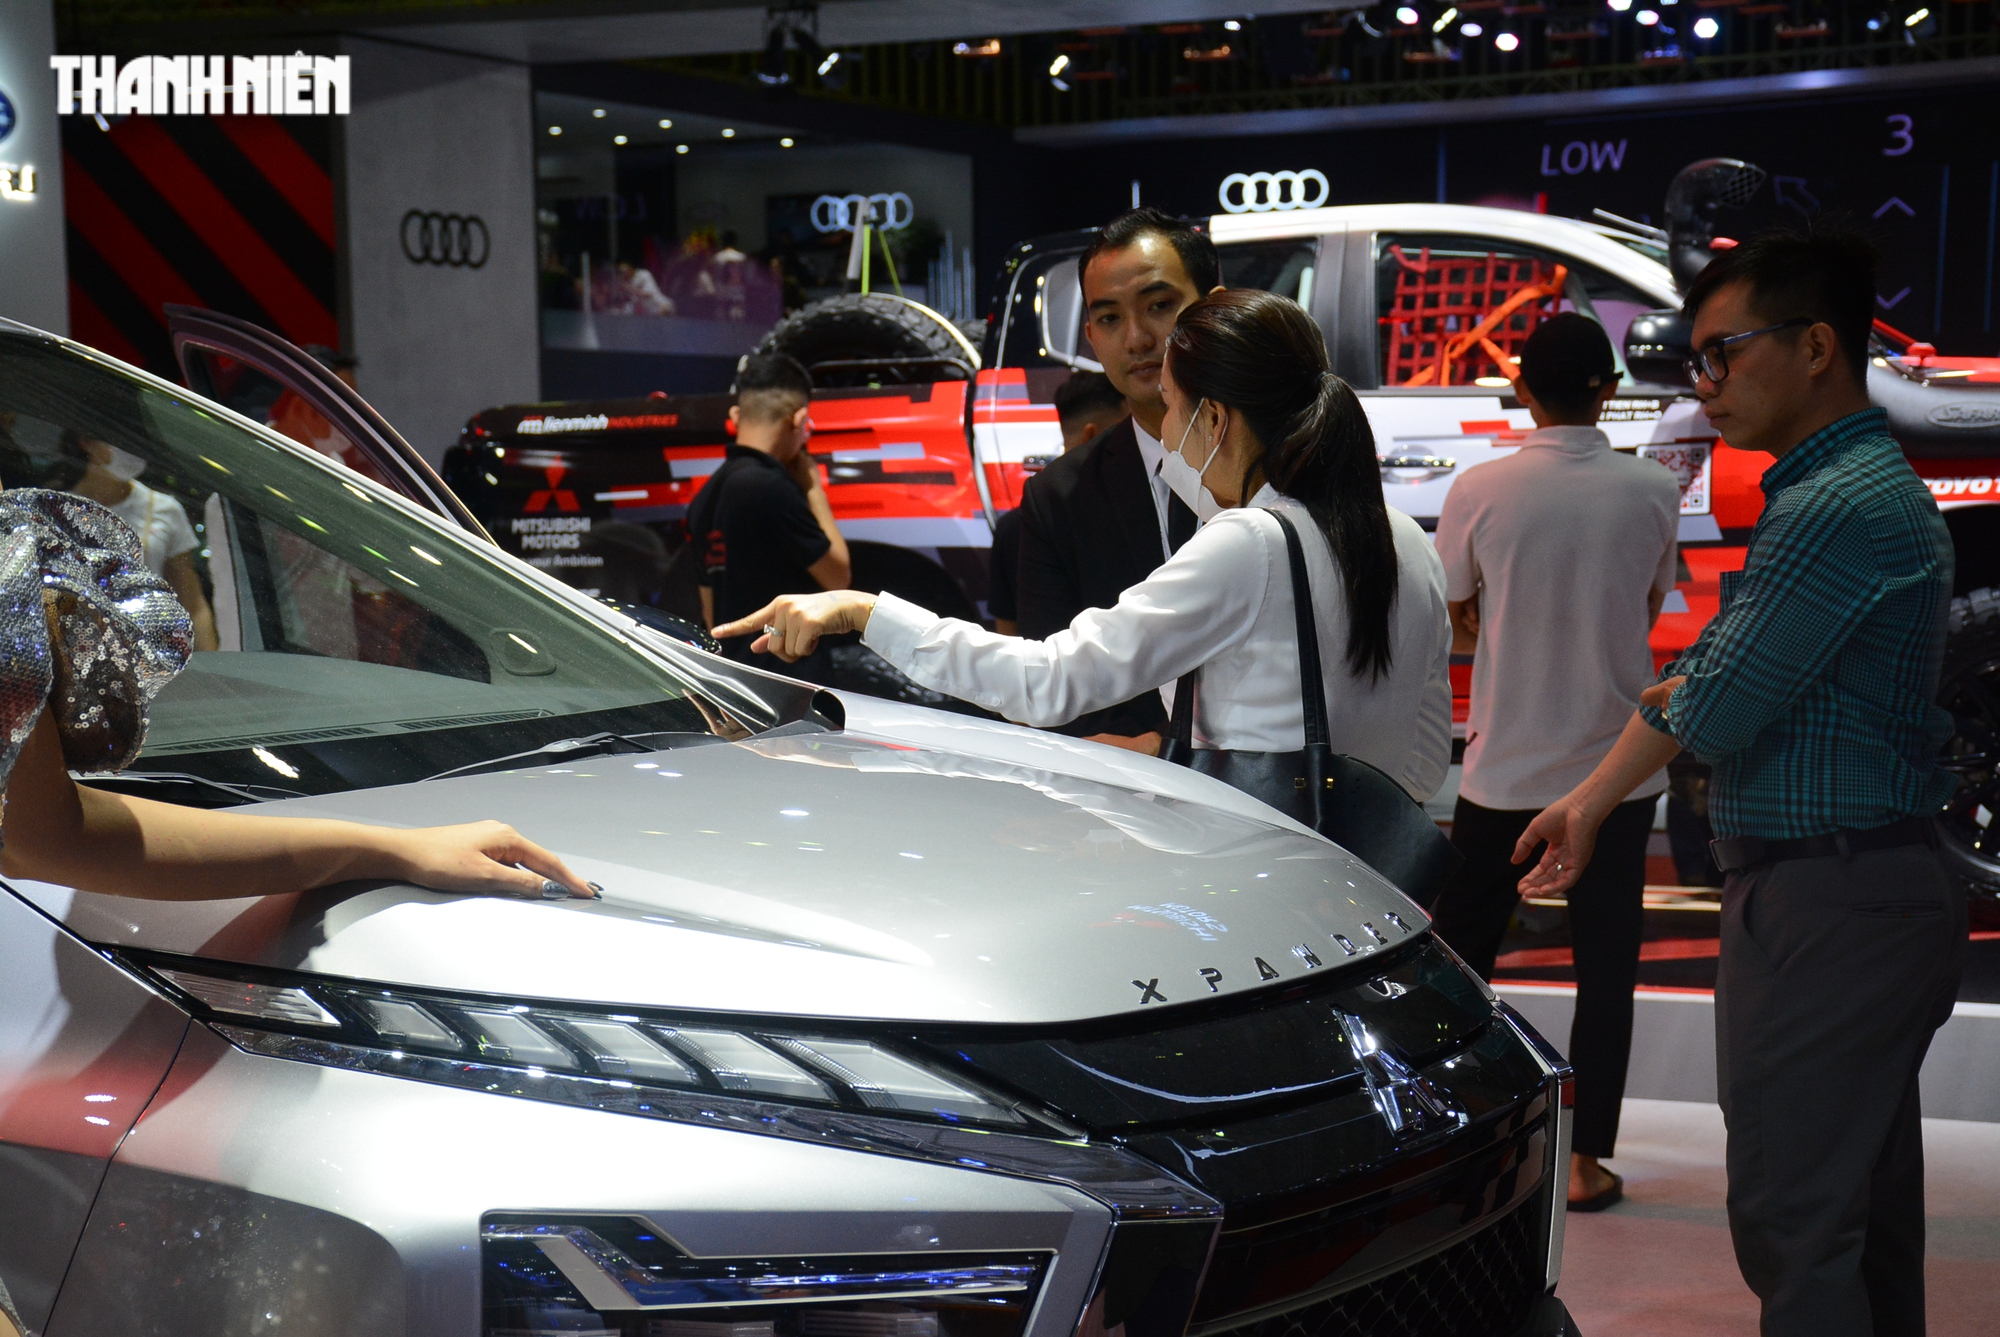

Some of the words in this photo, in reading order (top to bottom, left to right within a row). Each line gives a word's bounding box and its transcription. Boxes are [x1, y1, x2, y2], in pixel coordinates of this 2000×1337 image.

[1882, 113, 1914, 157] 3
[1540, 138, 1628, 177] LOW
[511, 517, 591, 534] MITSUBISHI
[521, 533, 581, 550] MOTORS
[553, 553, 604, 568] Ambition
[1131, 911, 1413, 1004] XPANDER
